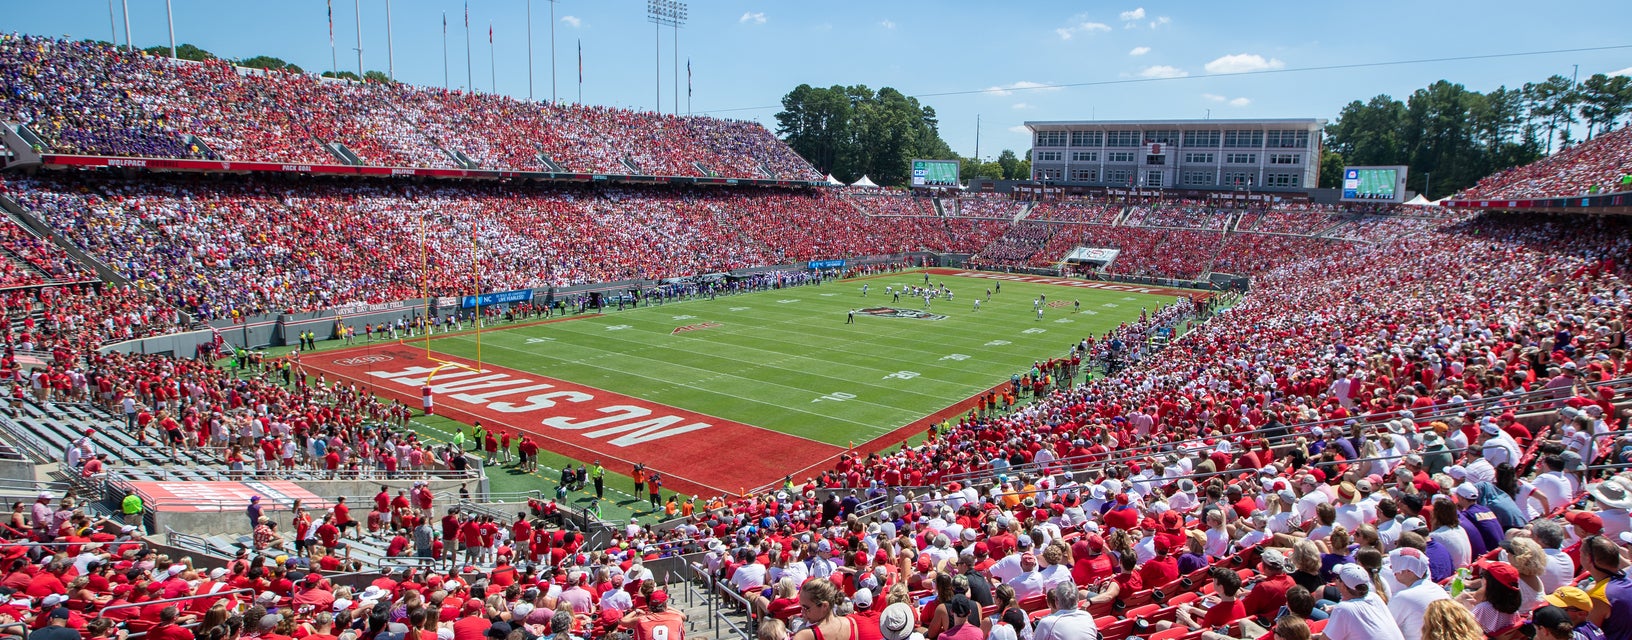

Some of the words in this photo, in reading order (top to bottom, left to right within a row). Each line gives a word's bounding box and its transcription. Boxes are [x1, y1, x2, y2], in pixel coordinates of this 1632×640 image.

[369, 303, 389, 311] FAMILY
[389, 301, 404, 309] FIELD
[365, 362, 595, 413] STATE
[541, 405, 713, 447] NC
